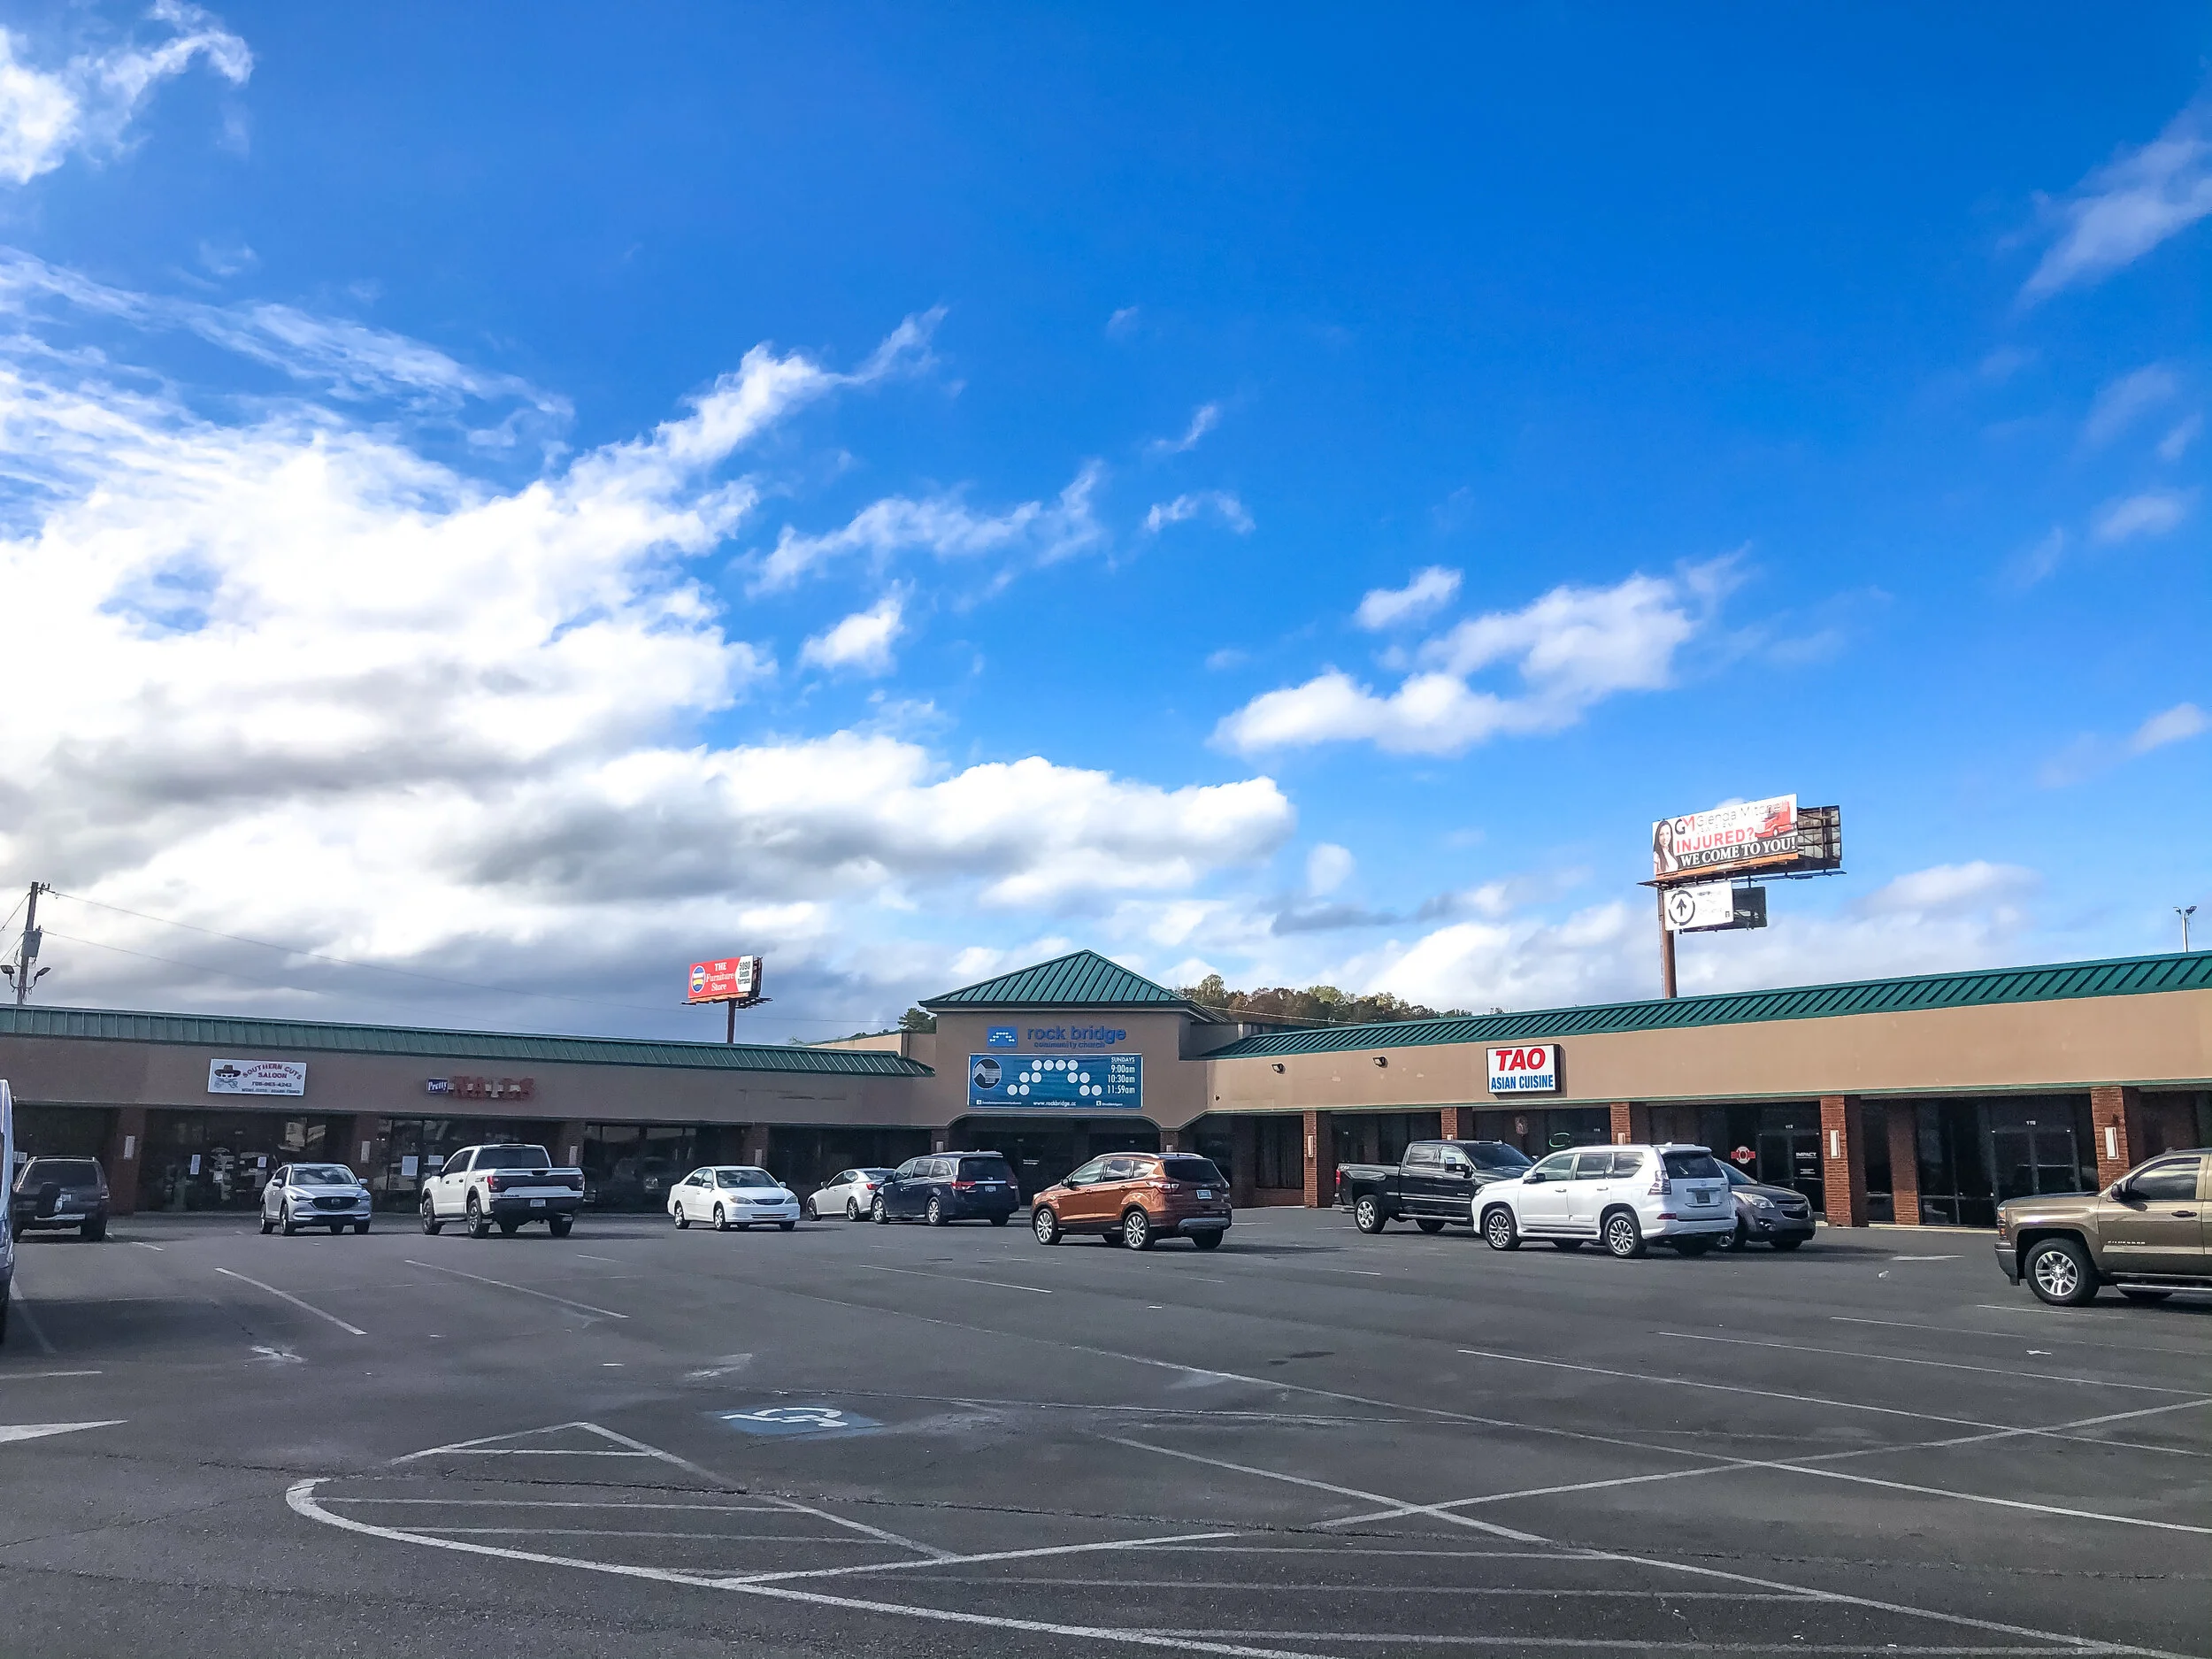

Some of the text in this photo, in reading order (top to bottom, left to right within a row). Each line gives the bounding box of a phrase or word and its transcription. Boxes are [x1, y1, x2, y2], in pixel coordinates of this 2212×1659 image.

[1676, 827, 1755, 853] INJURED?
[1680, 836, 1795, 867] WE COME TO YOU!
[715, 963, 726, 972] THE
[706, 972, 734, 982] Furniture
[711, 982, 727, 991] Store
[1027, 1025, 1126, 1044] rock bridge
[1495, 1048, 1546, 1071] TAO
[242, 1063, 283, 1078] SOUTHERN
[1110, 1064, 1135, 1073] 9:00am
[1108, 1074, 1135, 1083] 10:30am
[1491, 1074, 1554, 1089] ASIAN CUISINE
[1108, 1085, 1135, 1094] 11:59am
